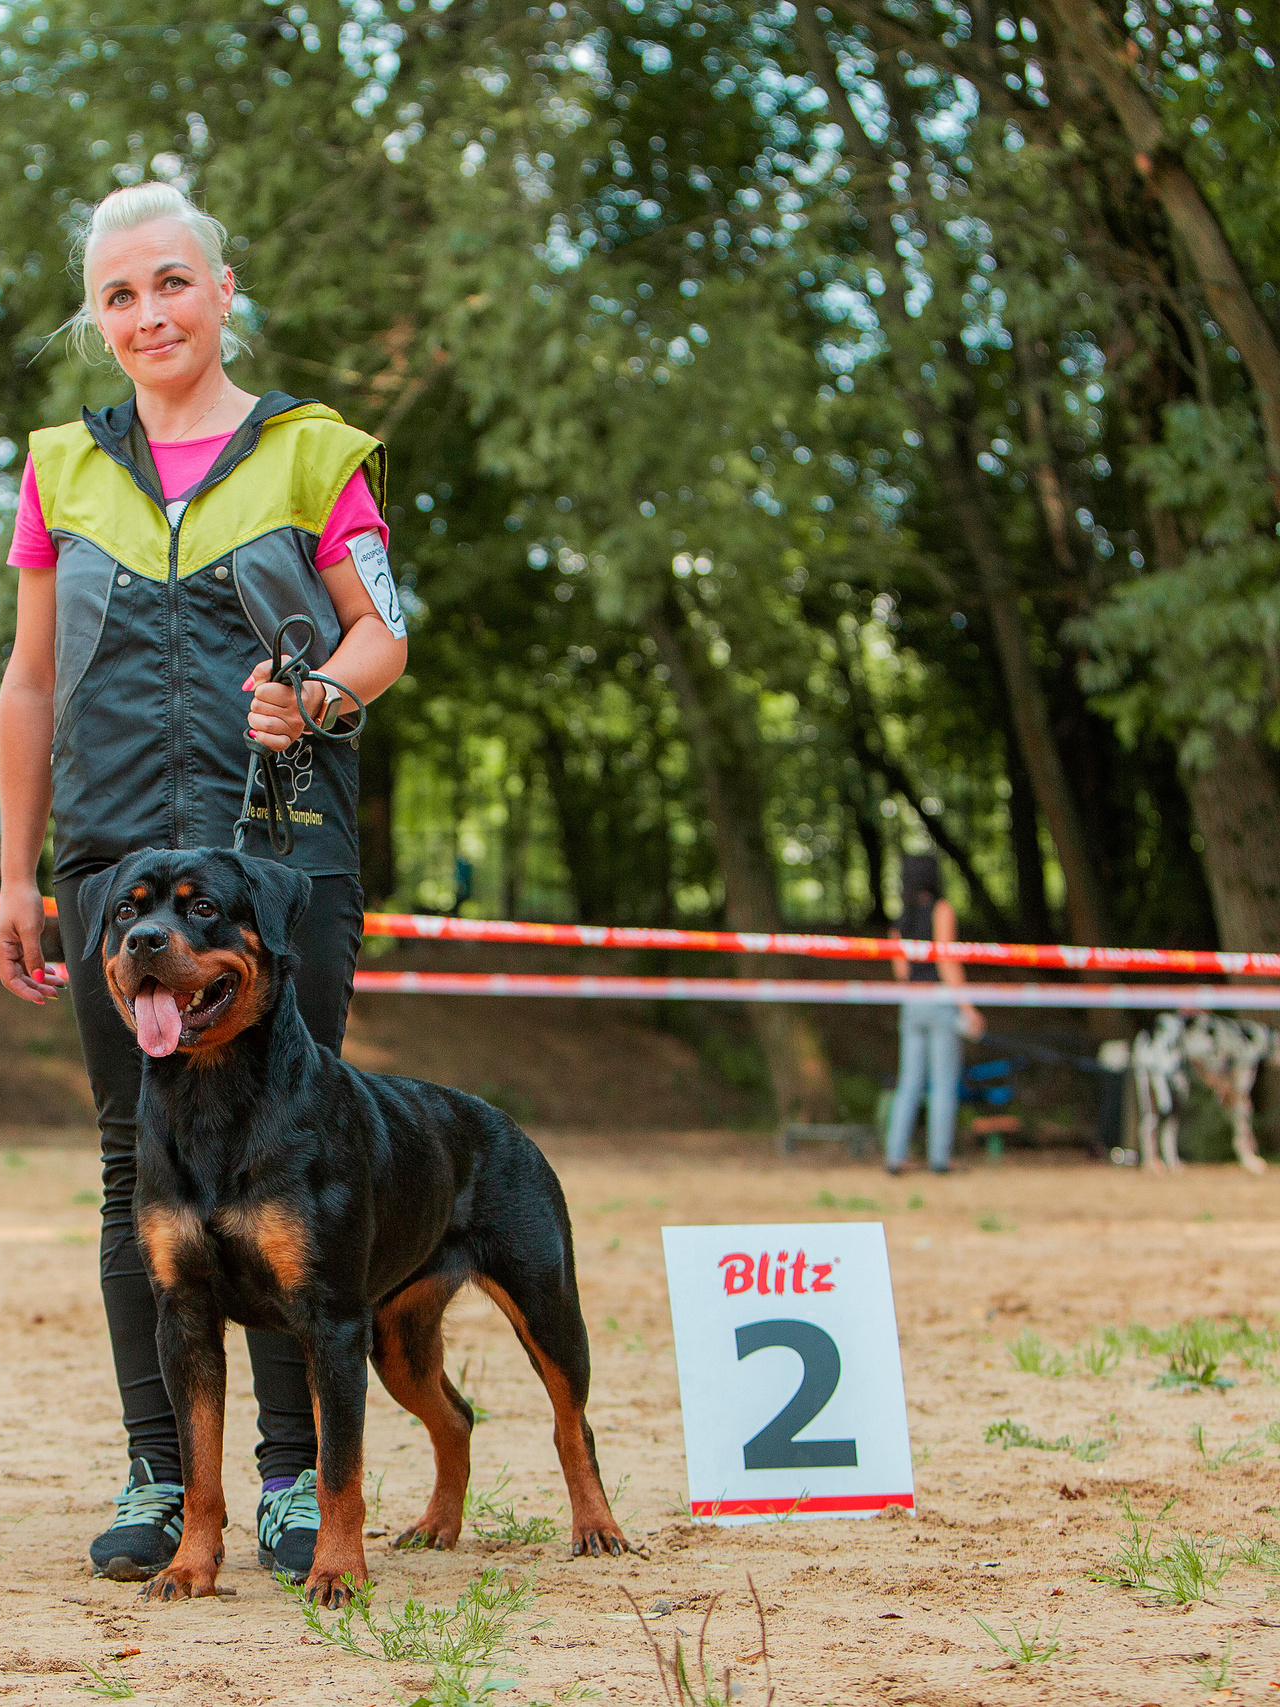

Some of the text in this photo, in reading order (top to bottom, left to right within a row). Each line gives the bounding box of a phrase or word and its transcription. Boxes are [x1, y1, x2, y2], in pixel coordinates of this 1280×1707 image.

[374, 572, 402, 623] 2
[257, 806, 269, 820] are
[287, 805, 323, 827] hampions
[718, 1248, 837, 1296] Blitz
[734, 1318, 859, 1470] 2
